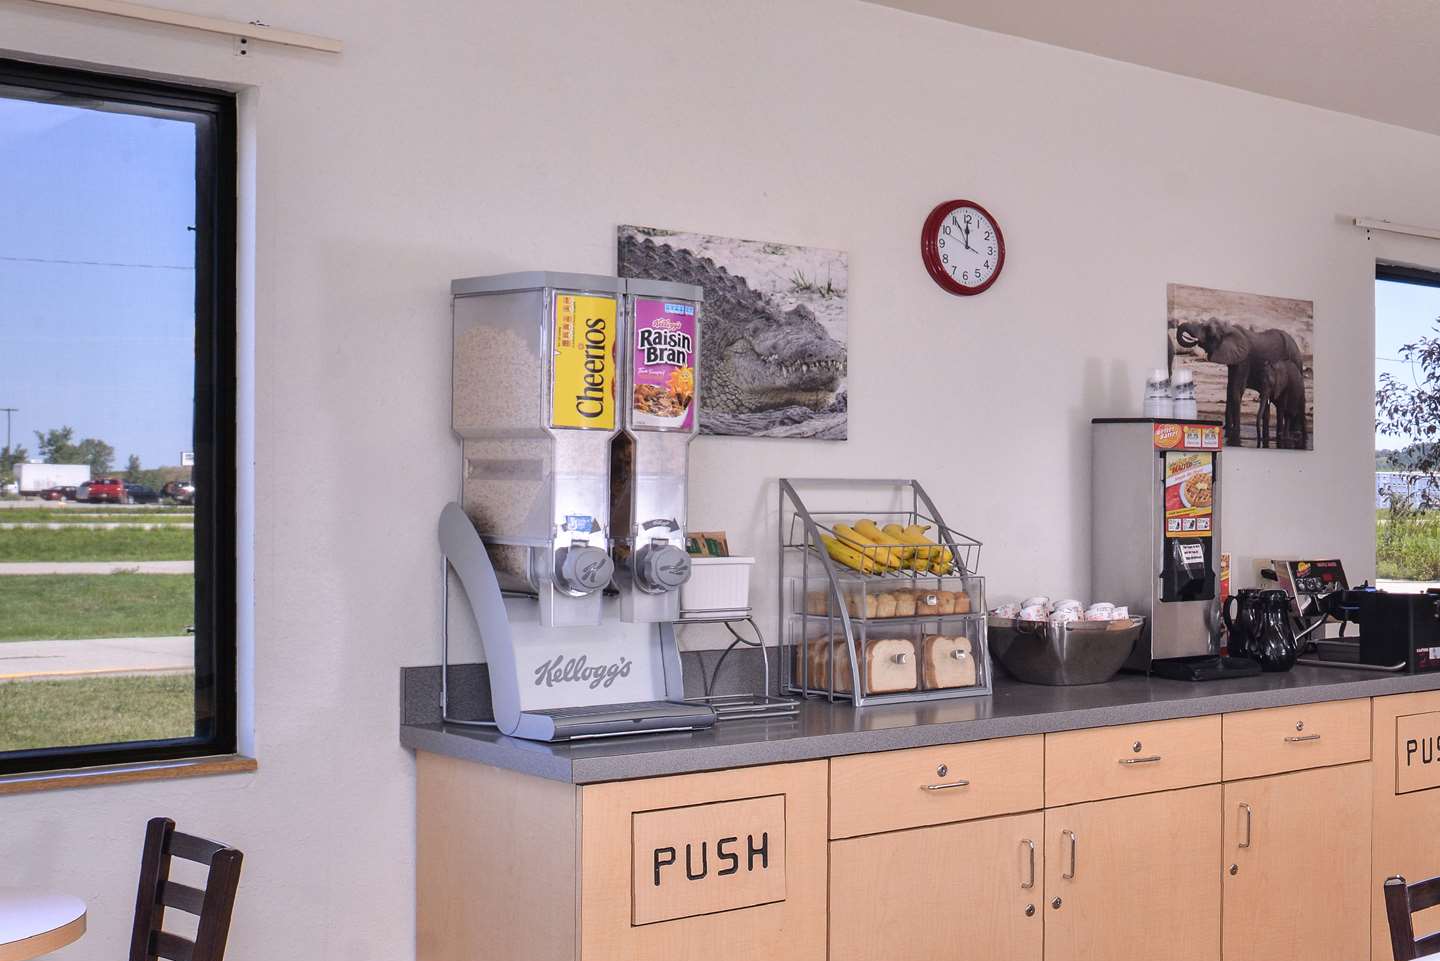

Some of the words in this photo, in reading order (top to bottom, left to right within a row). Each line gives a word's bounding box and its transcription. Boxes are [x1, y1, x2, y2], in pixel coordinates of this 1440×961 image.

[964, 214, 972, 224] 12
[943, 225, 952, 235] 10
[984, 230, 990, 241] 2
[939, 239, 946, 248] 9
[987, 246, 993, 256] 3
[942, 254, 949, 264] 8
[984, 260, 990, 269] 4
[952, 265, 957, 275] 7
[975, 268, 981, 278] 5
[962, 271, 968, 280] 6
[639, 328, 692, 353] Raisin
[646, 346, 686, 364] Bran
[576, 318, 606, 418] Cheerios
[534, 654, 633, 690] Kellogg's
[653, 831, 769, 887] PUSH
